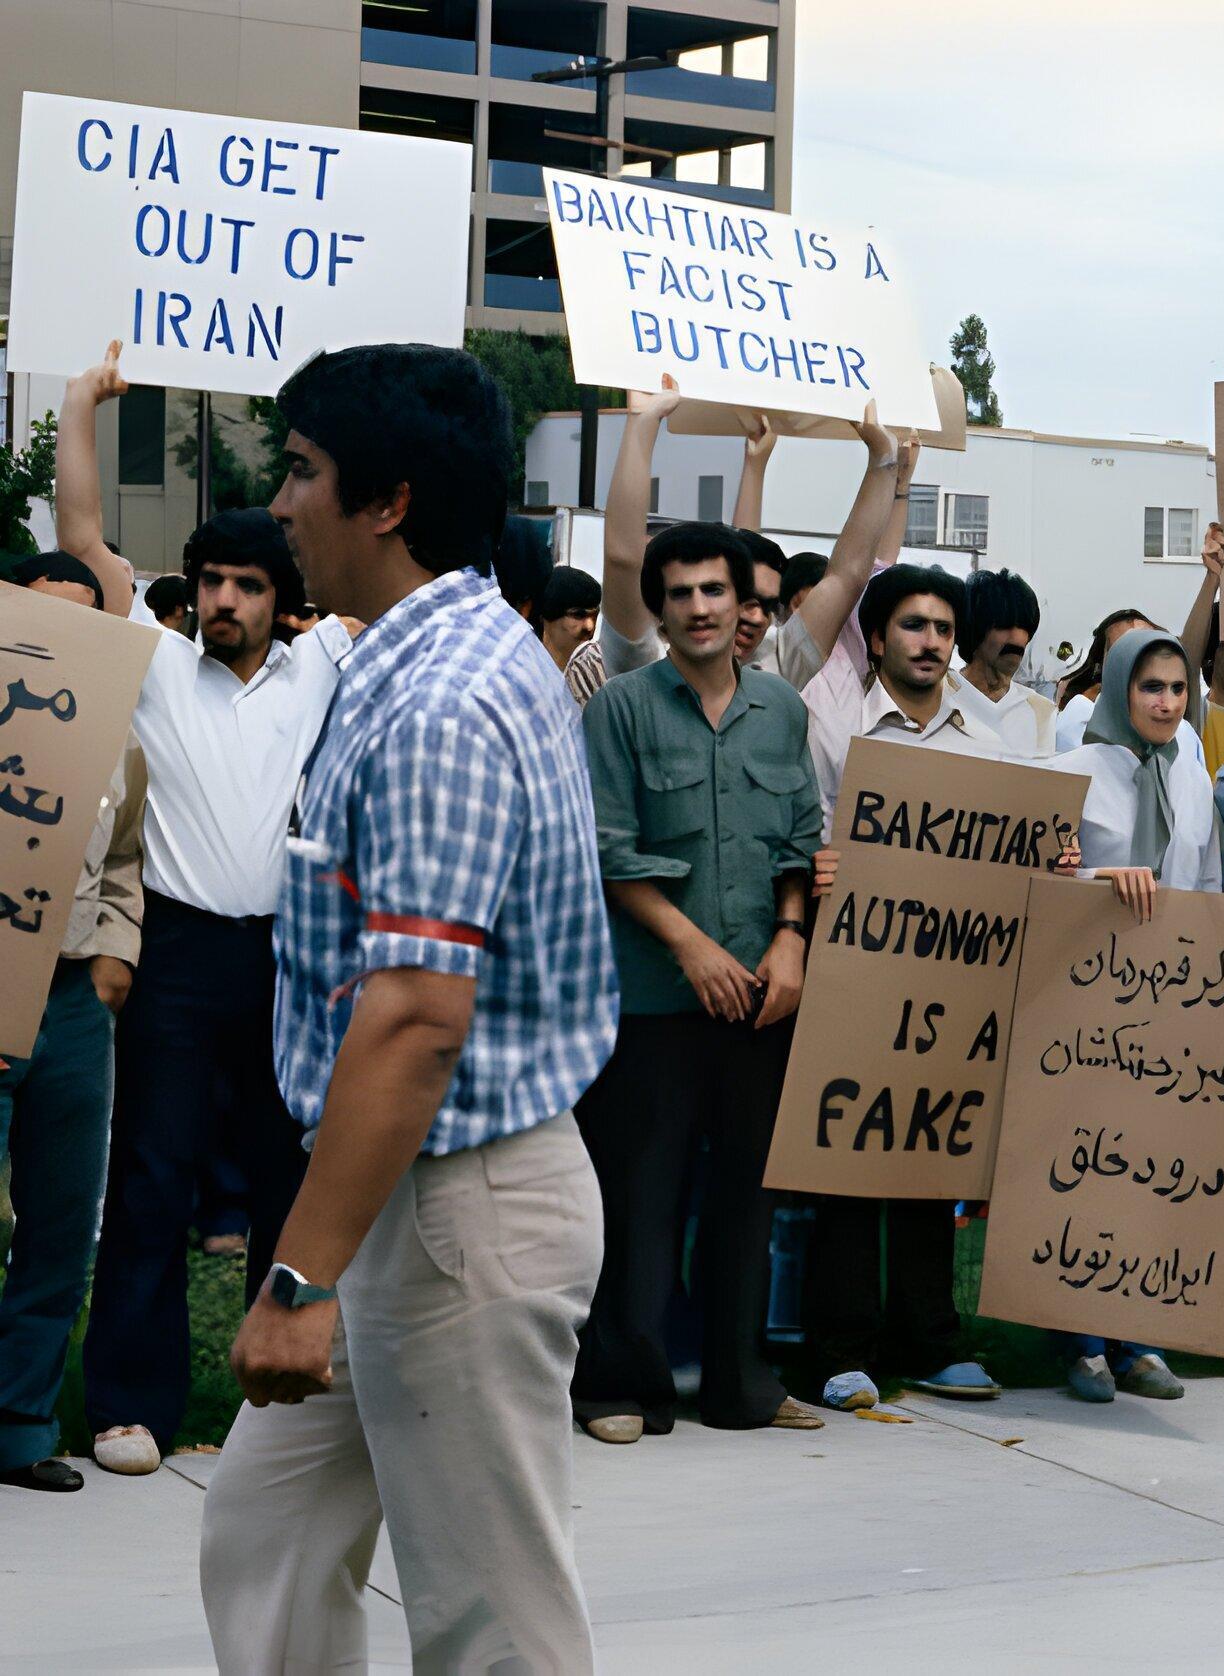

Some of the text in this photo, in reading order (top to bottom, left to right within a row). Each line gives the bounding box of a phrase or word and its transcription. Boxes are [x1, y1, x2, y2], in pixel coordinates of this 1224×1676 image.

[77, 118, 340, 200] CIA GET
[135, 204, 366, 287] OUT OF
[552, 180, 890, 282] BAKHTIAR IS A
[133, 288, 283, 361] IRAN
[622, 250, 794, 321] FACIST
[631, 309, 871, 391] BUTCHER
[893, 999, 998, 1062] IS A
[816, 1078, 985, 1157] FAKE
